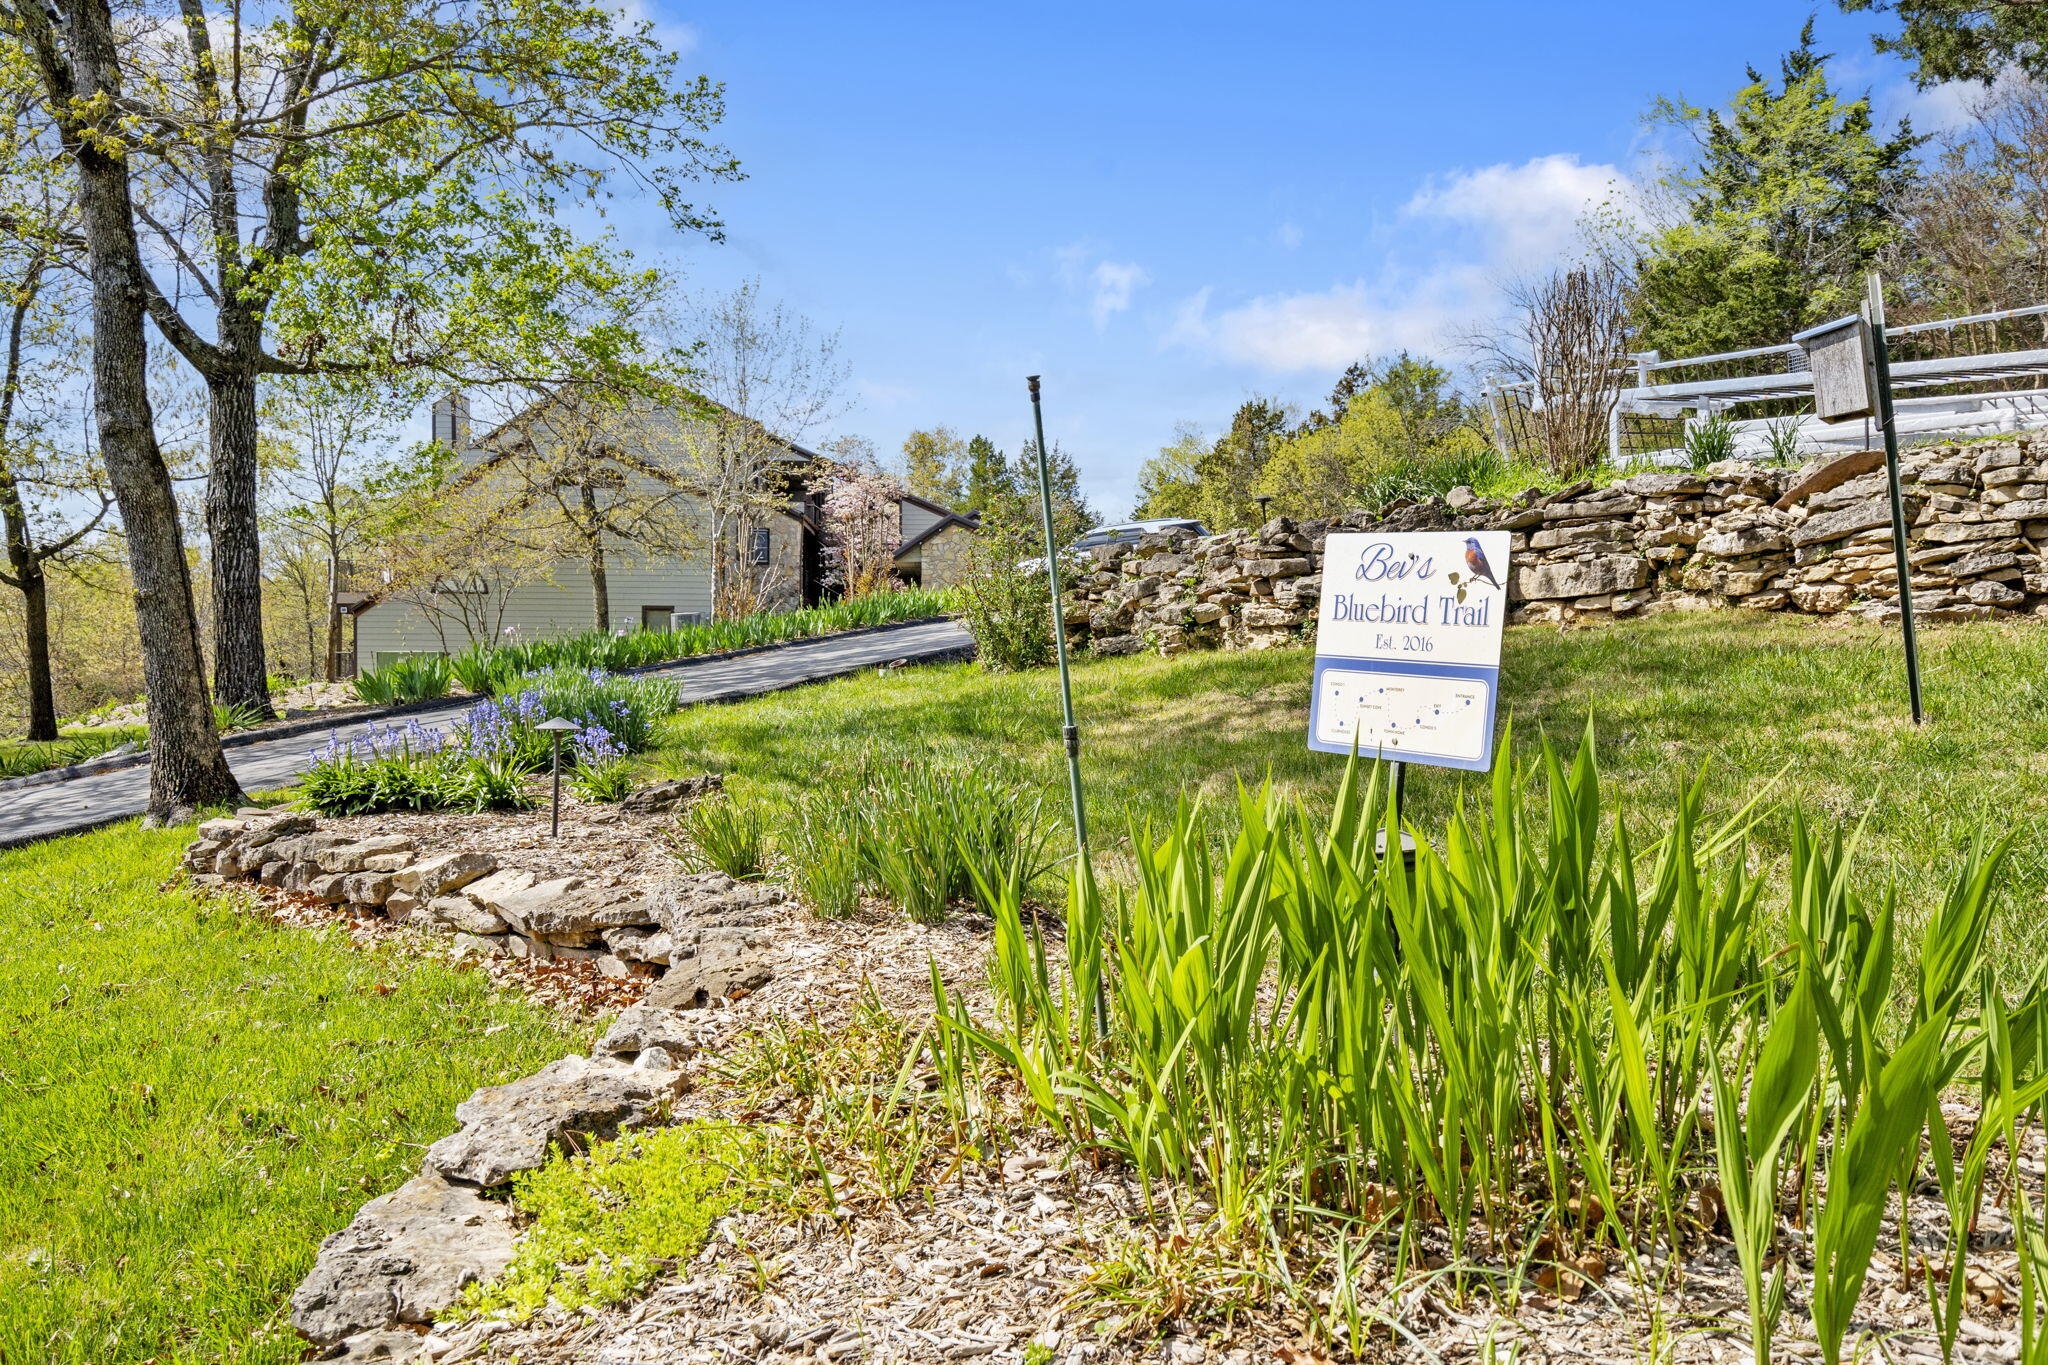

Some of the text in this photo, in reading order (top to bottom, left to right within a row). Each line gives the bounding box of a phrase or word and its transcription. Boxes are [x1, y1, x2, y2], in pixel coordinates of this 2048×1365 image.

[1355, 542, 1436, 582] Bev's
[1333, 592, 1489, 627] Bluebird Trail
[1376, 634, 1434, 652] Est. 2016
